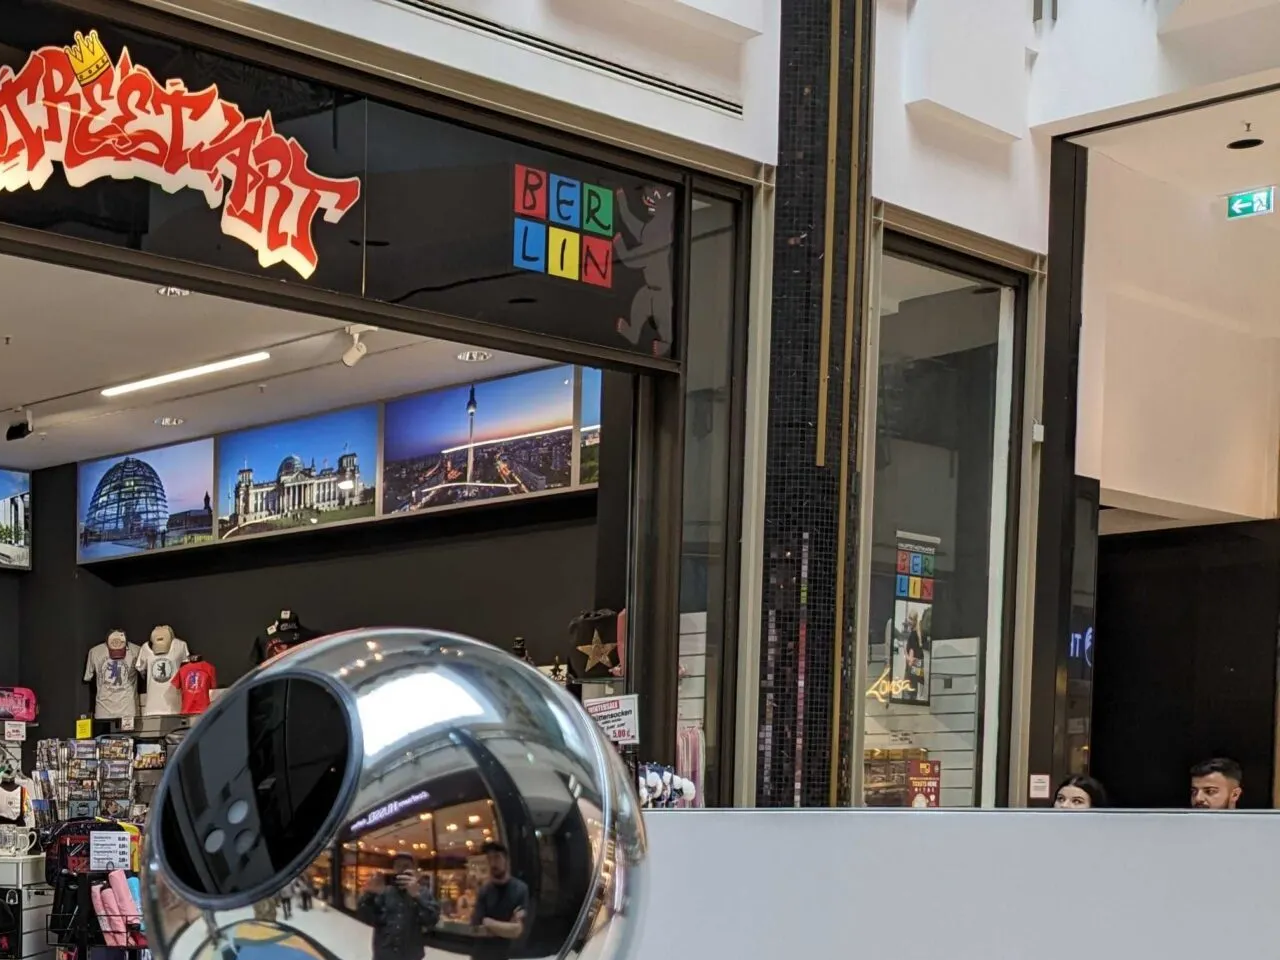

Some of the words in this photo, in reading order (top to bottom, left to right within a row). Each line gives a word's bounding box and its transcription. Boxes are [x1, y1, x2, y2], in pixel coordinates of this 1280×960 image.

[195, 110, 361, 279] ART
[522, 168, 611, 232] BER
[519, 221, 613, 283] LIN
